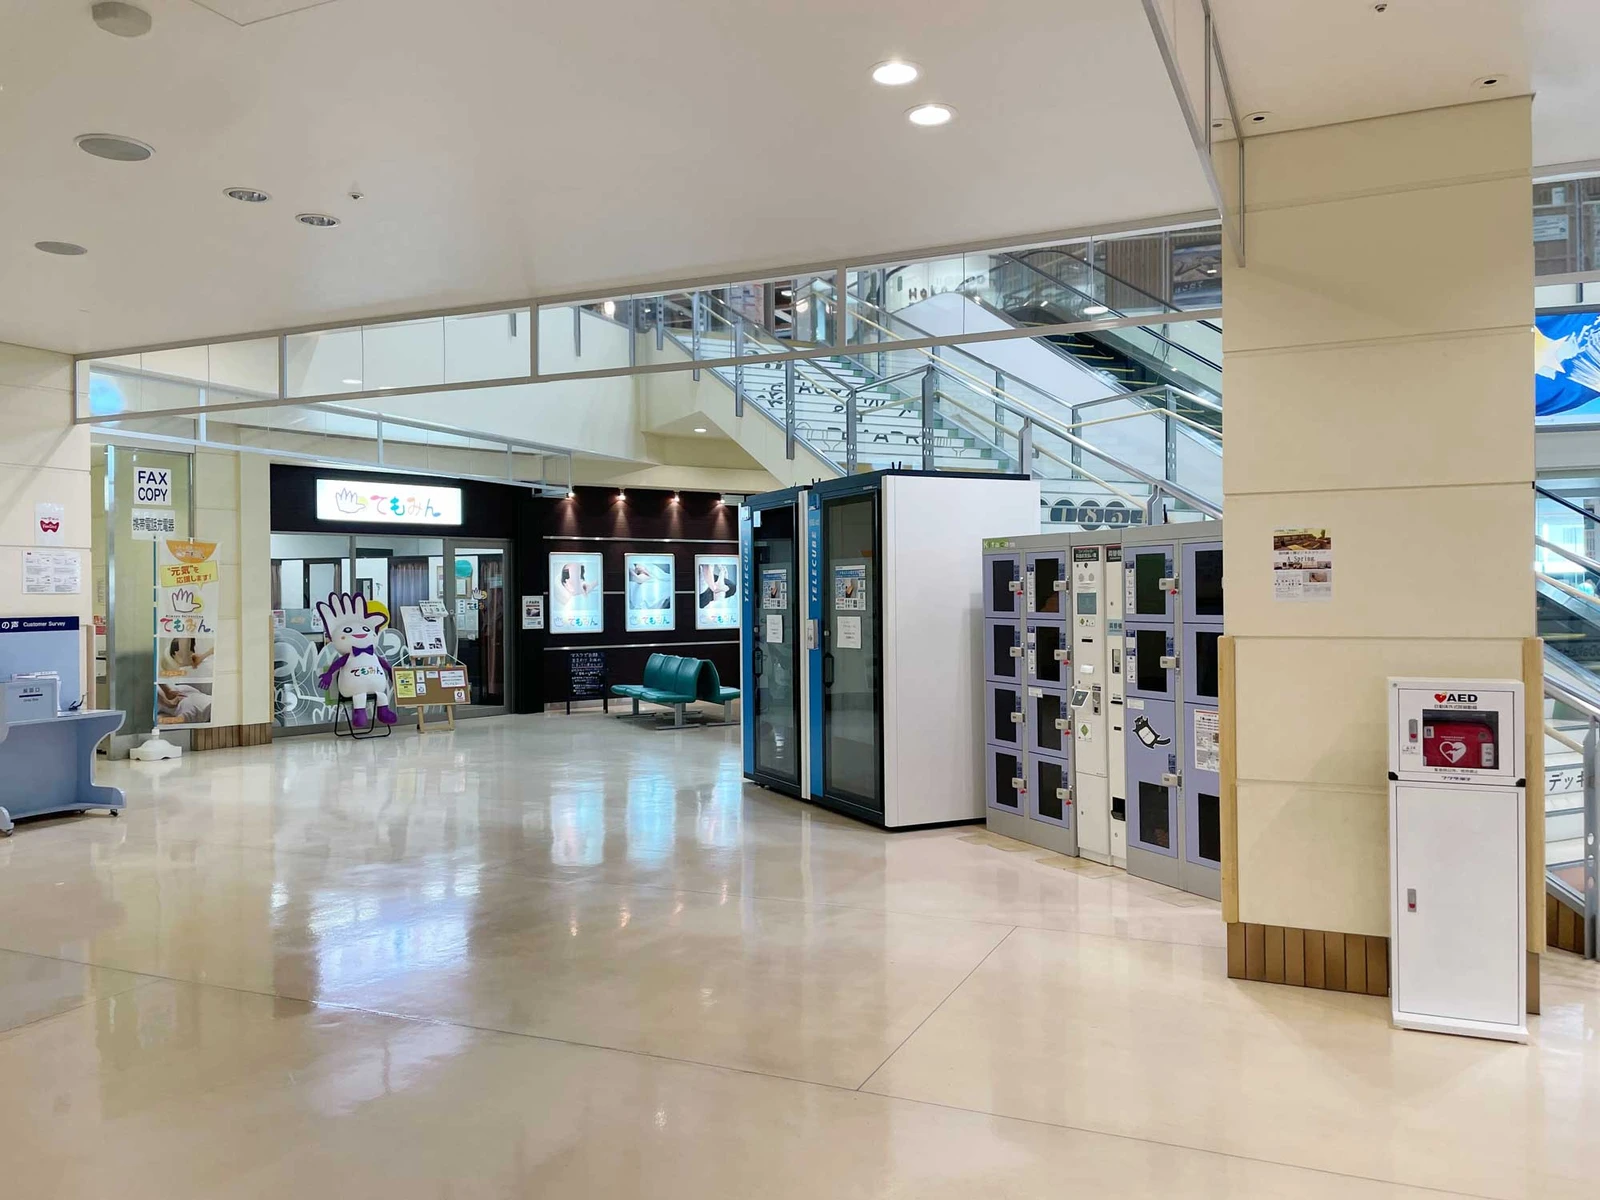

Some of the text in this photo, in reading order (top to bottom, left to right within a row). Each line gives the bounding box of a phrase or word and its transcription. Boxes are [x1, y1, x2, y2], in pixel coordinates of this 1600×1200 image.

[137, 470, 168, 485] FAX
[137, 486, 168, 502] COPY
[370, 497, 441, 516] てもみん
[132, 517, 175, 532] 携帯電話充電器
[160, 617, 212, 633] てもみん
[1446, 693, 1478, 703] AED
